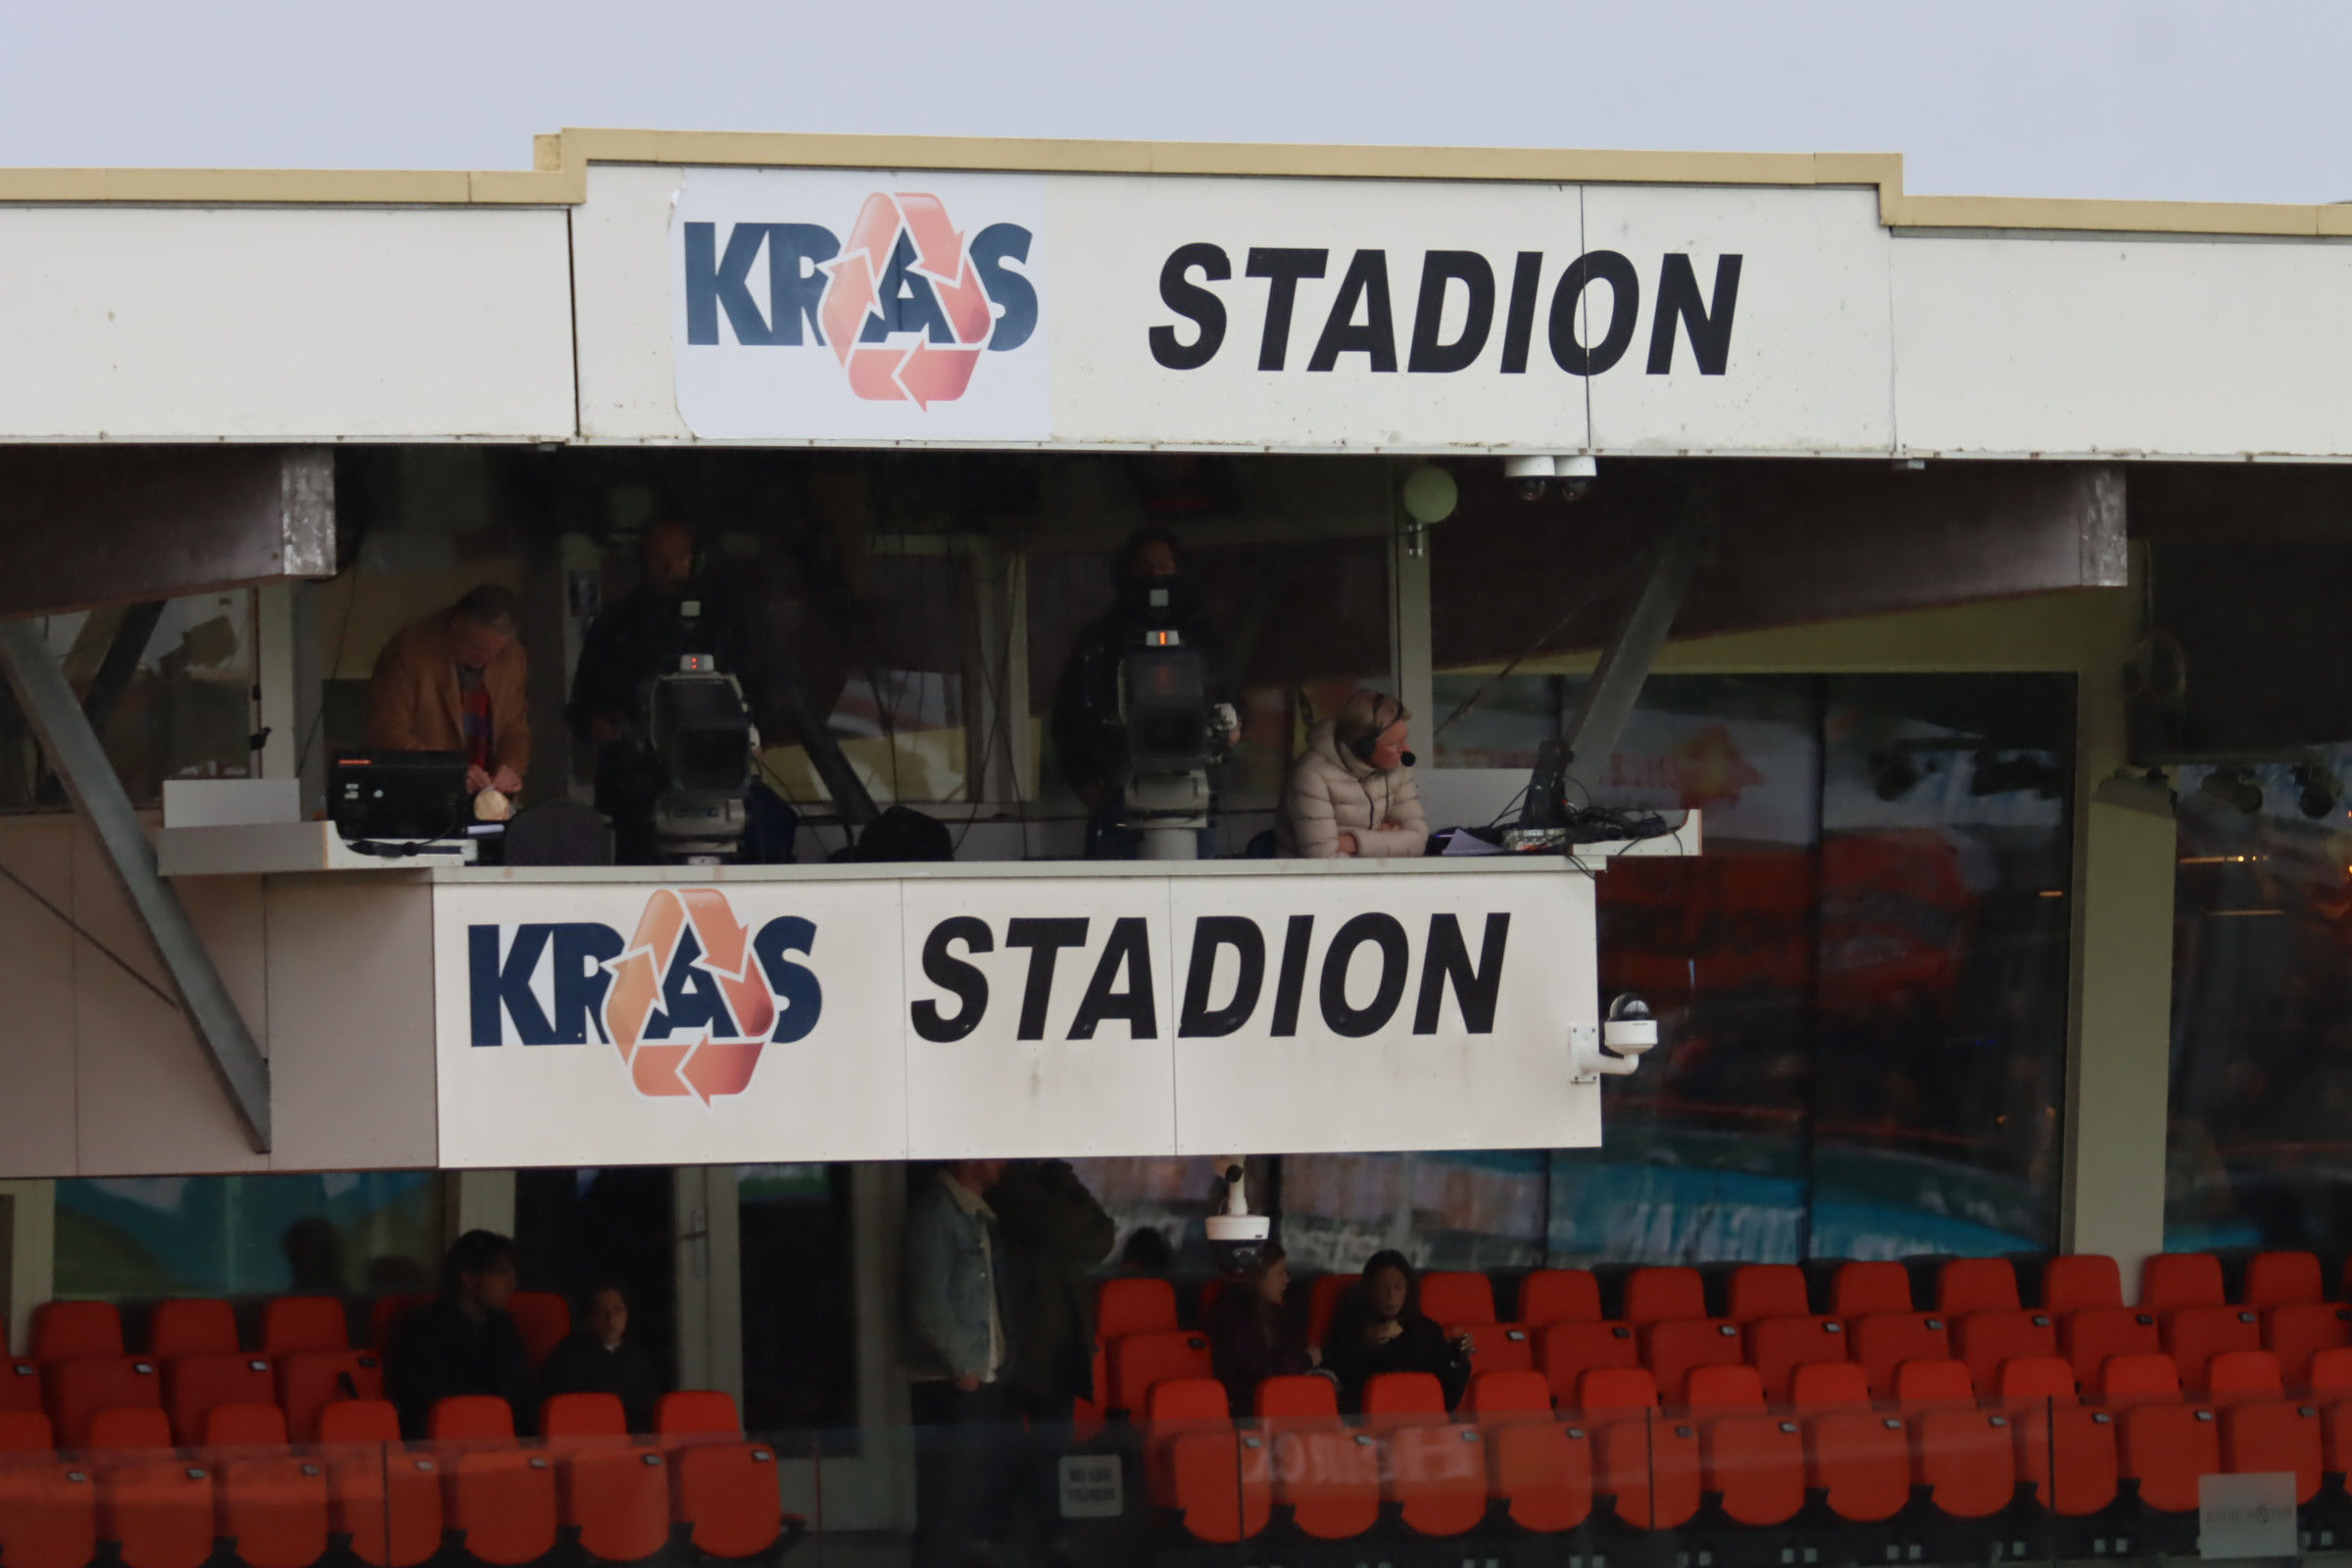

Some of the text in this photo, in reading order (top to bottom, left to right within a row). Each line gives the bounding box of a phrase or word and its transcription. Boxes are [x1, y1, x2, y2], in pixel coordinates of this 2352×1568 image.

[684, 221, 1743, 376] KRAS STADION
[467, 911, 1511, 1048] KRAS STADION
